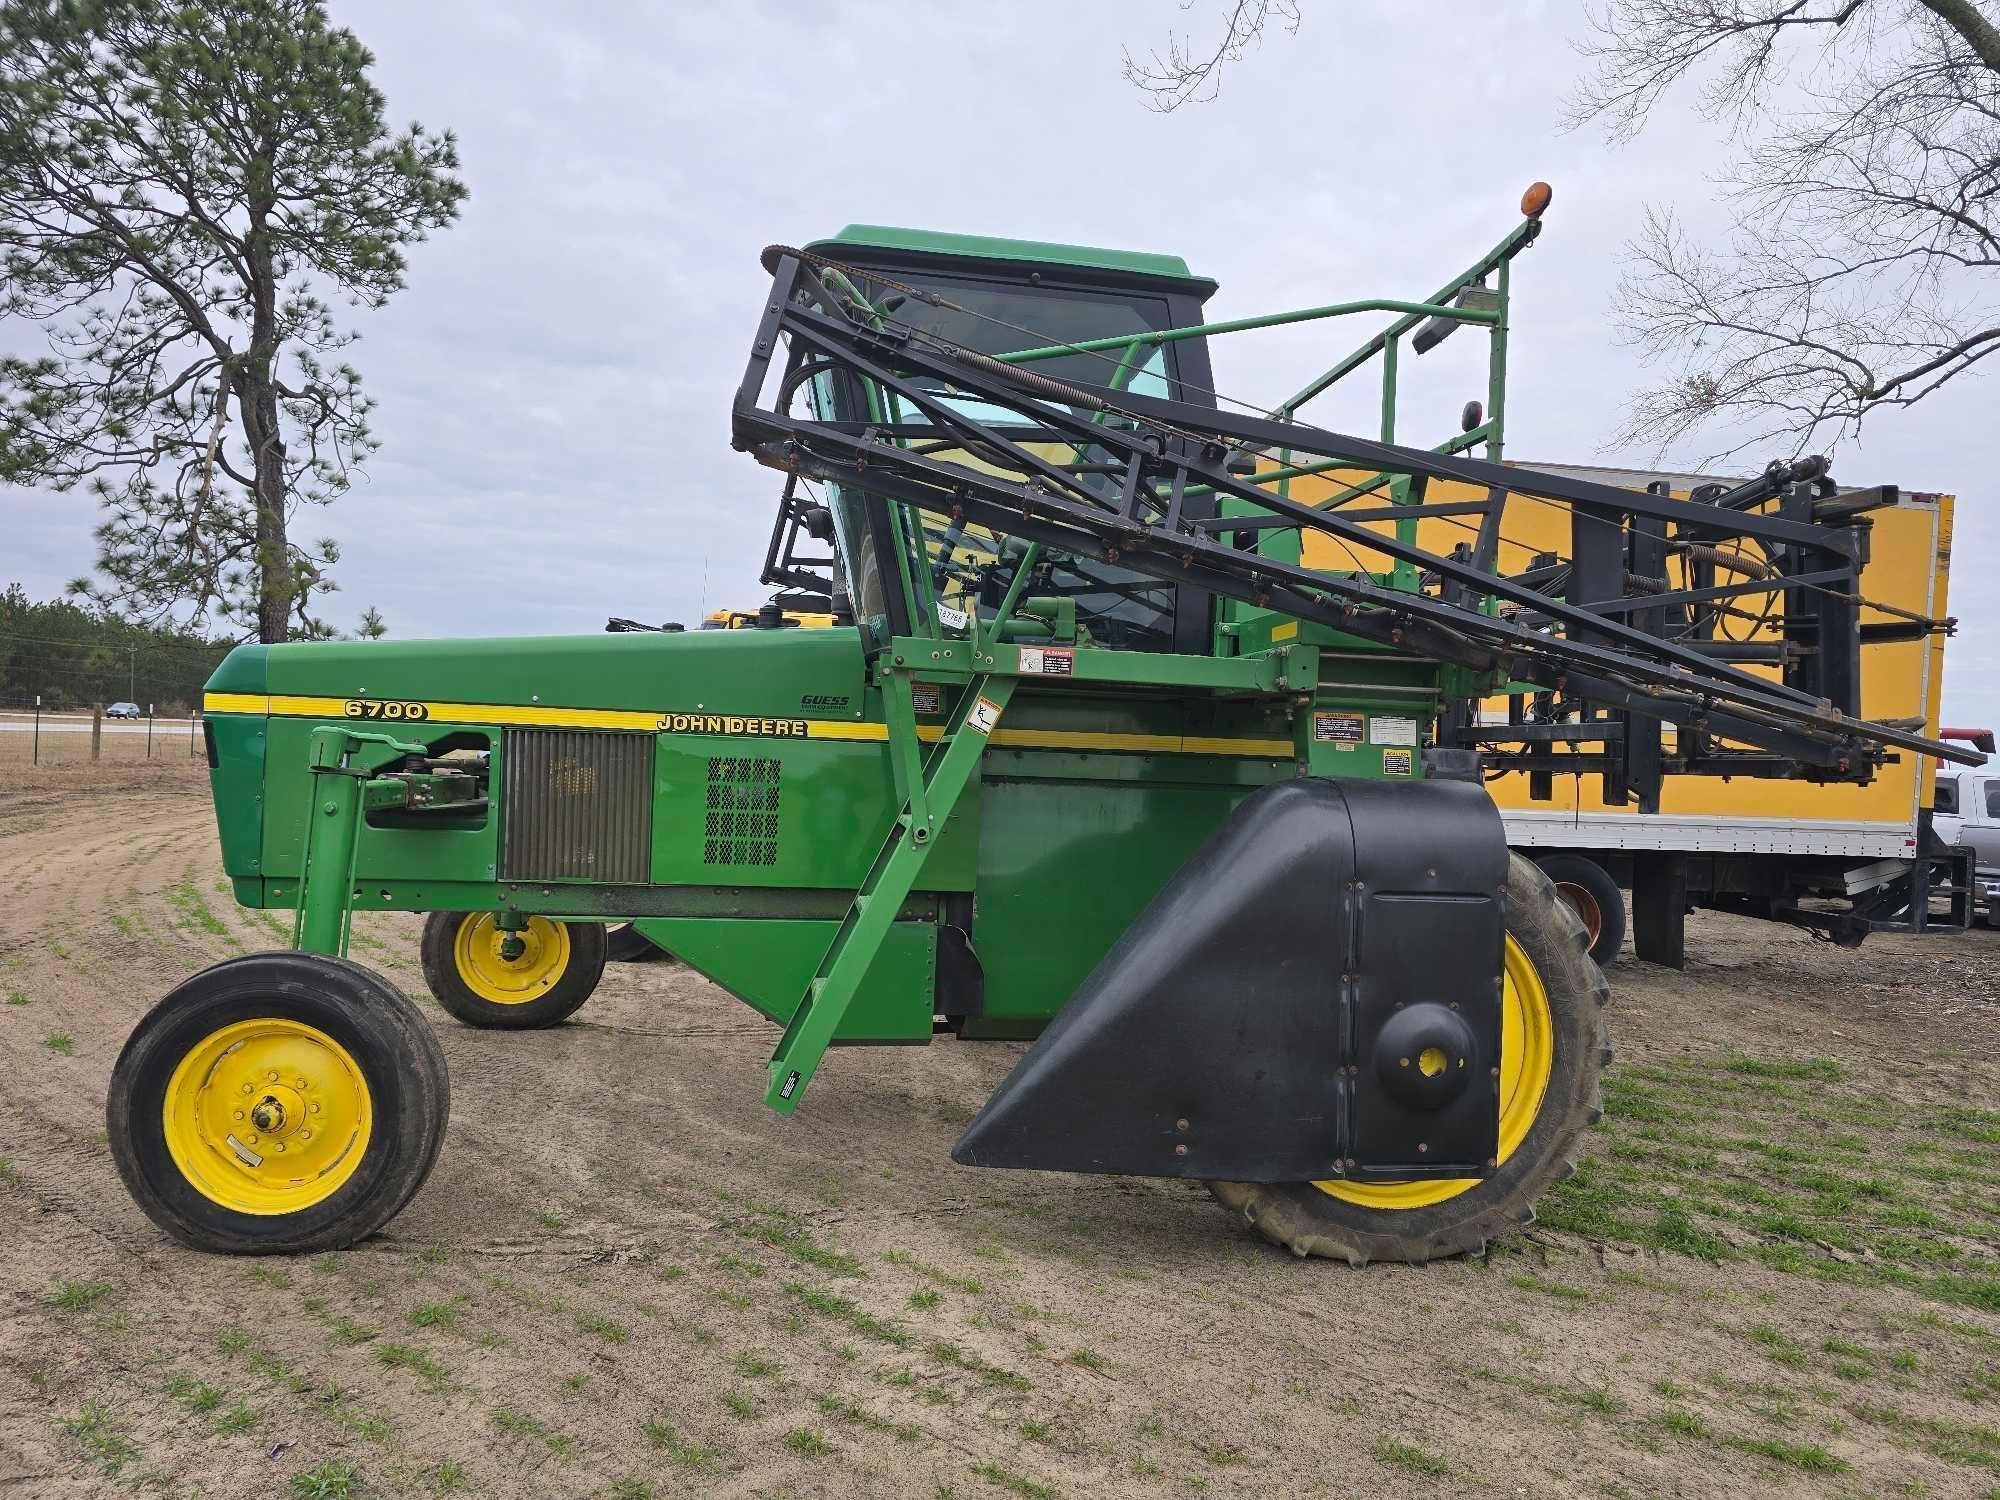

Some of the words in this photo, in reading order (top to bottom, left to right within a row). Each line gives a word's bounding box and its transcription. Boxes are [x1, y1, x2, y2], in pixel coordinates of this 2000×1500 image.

[344, 700, 427, 720] 6700
[801, 695, 850, 705] GUESS
[656, 714, 722, 733] JOHN
[728, 716, 808, 737] DEERE
